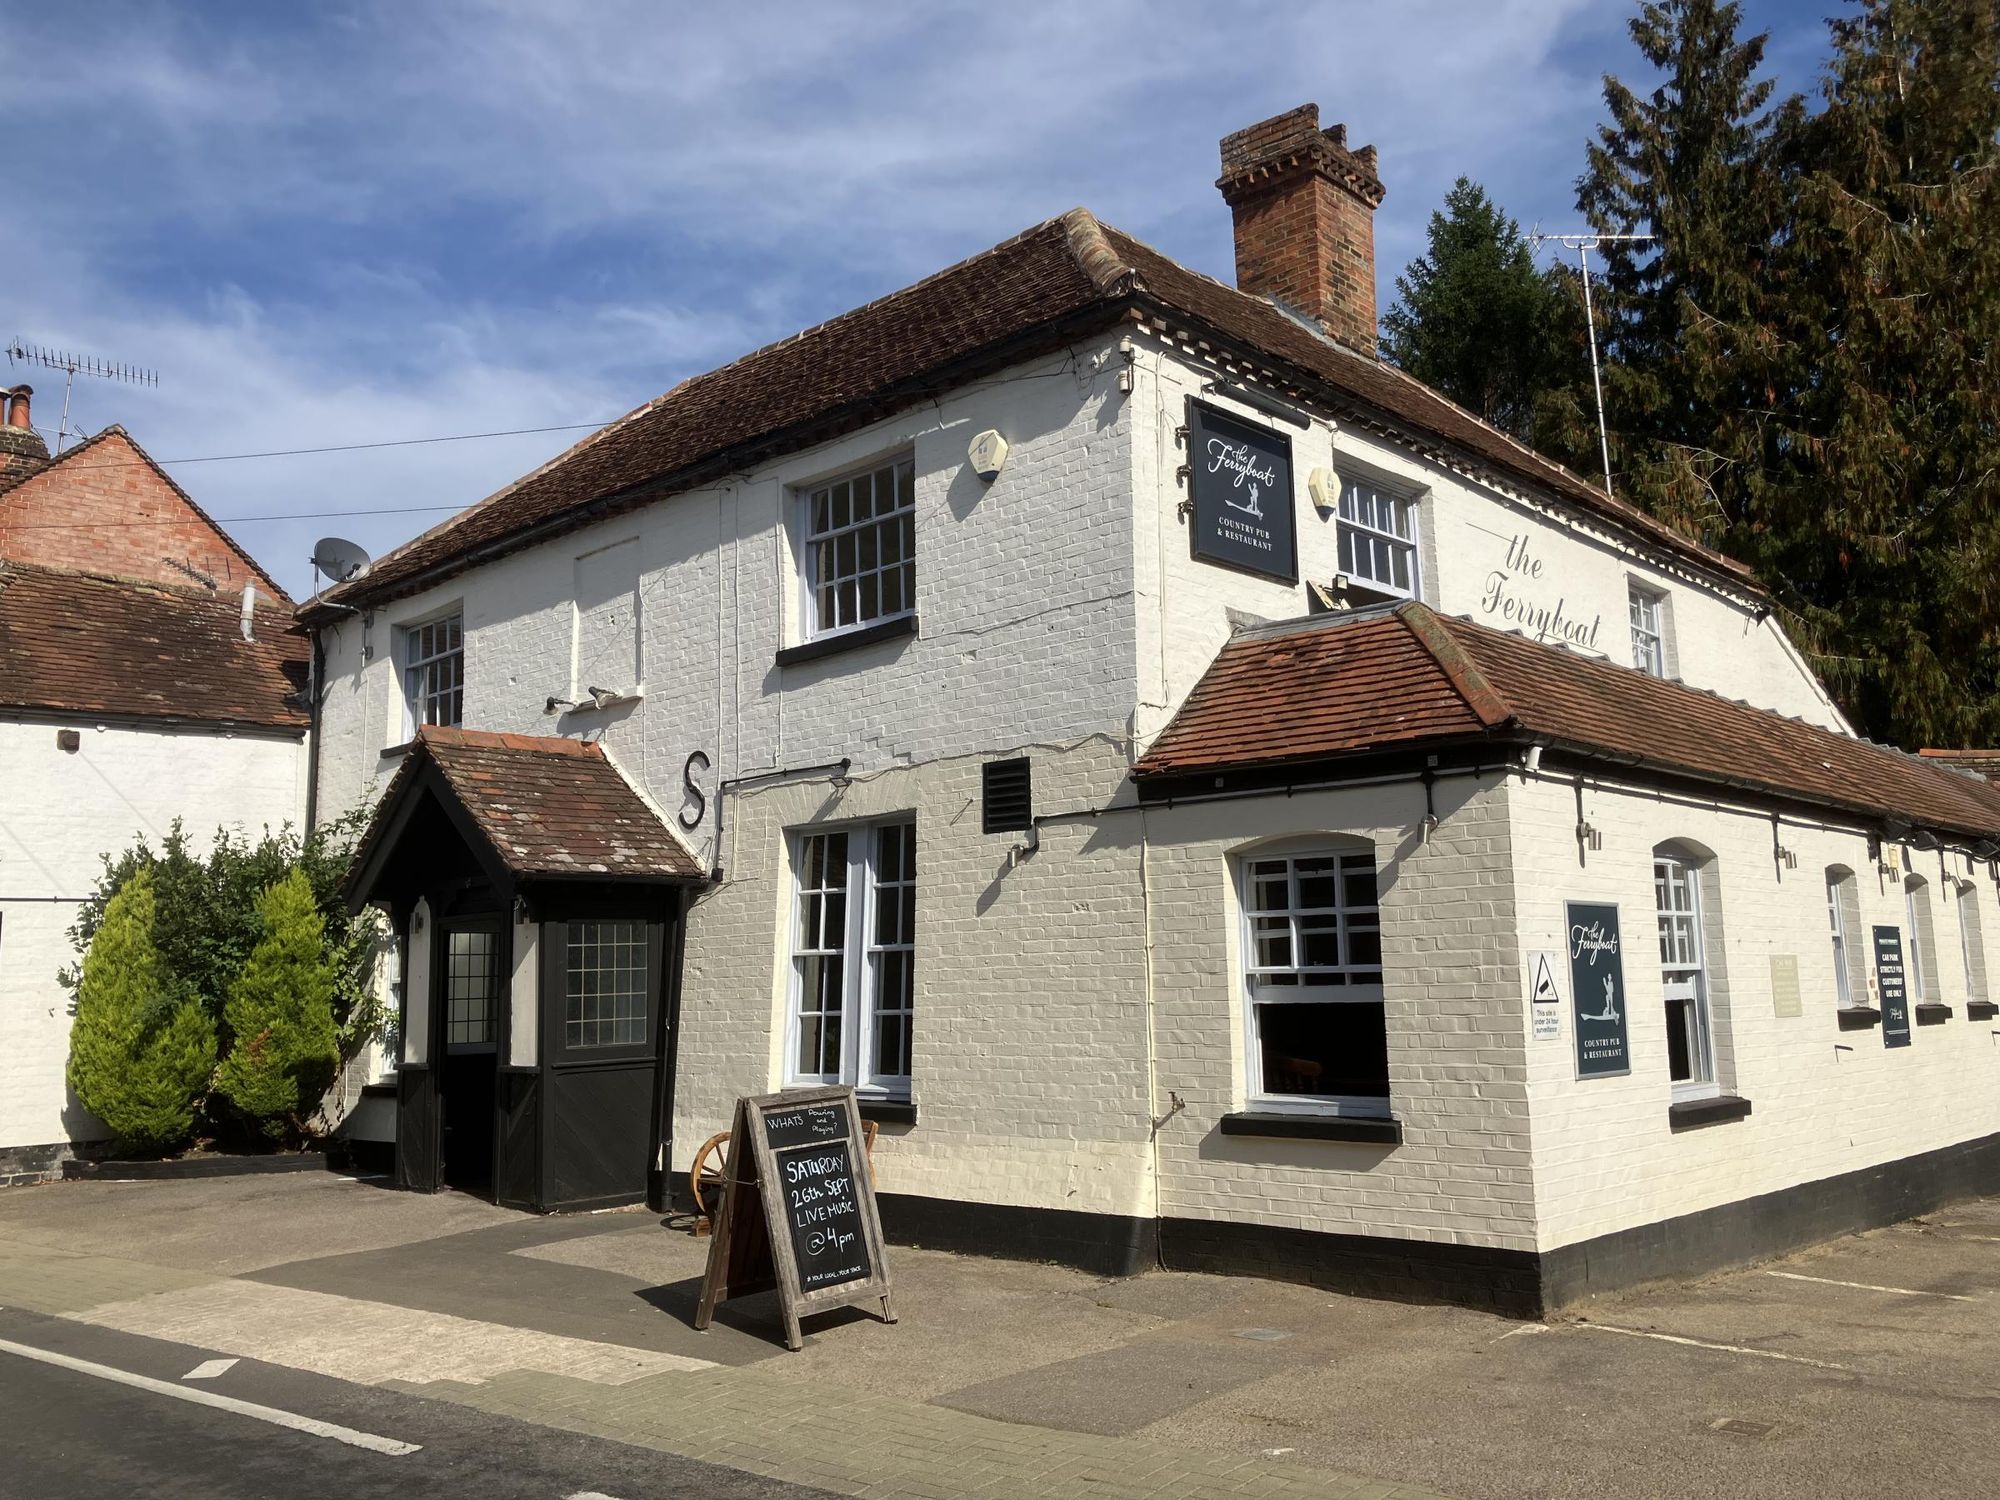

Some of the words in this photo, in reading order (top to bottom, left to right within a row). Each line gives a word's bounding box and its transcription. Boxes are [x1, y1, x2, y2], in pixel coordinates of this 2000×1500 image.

[1207, 438, 1275, 487] Ferryboat
[1231, 444, 1249, 464] the
[1217, 527, 1223, 536] &
[1225, 529, 1272, 552] RESTAURANT
[1218, 516, 1255, 535] COUNTRY
[1255, 527, 1270, 540] PUB
[1504, 534, 1543, 579] the
[1481, 570, 1602, 648] Ferryboat
[1571, 924, 1618, 966] Ferryboat
[1583, 1051, 1588, 1060] &
[1589, 1048, 1622, 1059] RESTAURANT
[1584, 1038, 1609, 1048] COUNTRY
[1609, 1037, 1620, 1046] PUB
[767, 1114, 804, 1130] WHAT'S
[786, 1154, 844, 1184] SATURDAY
[791, 1186, 824, 1209] 26th
[824, 1178, 849, 1196] SEPT
[796, 1206, 827, 1228] LIVE
[826, 1199, 855, 1218] MUSIC
